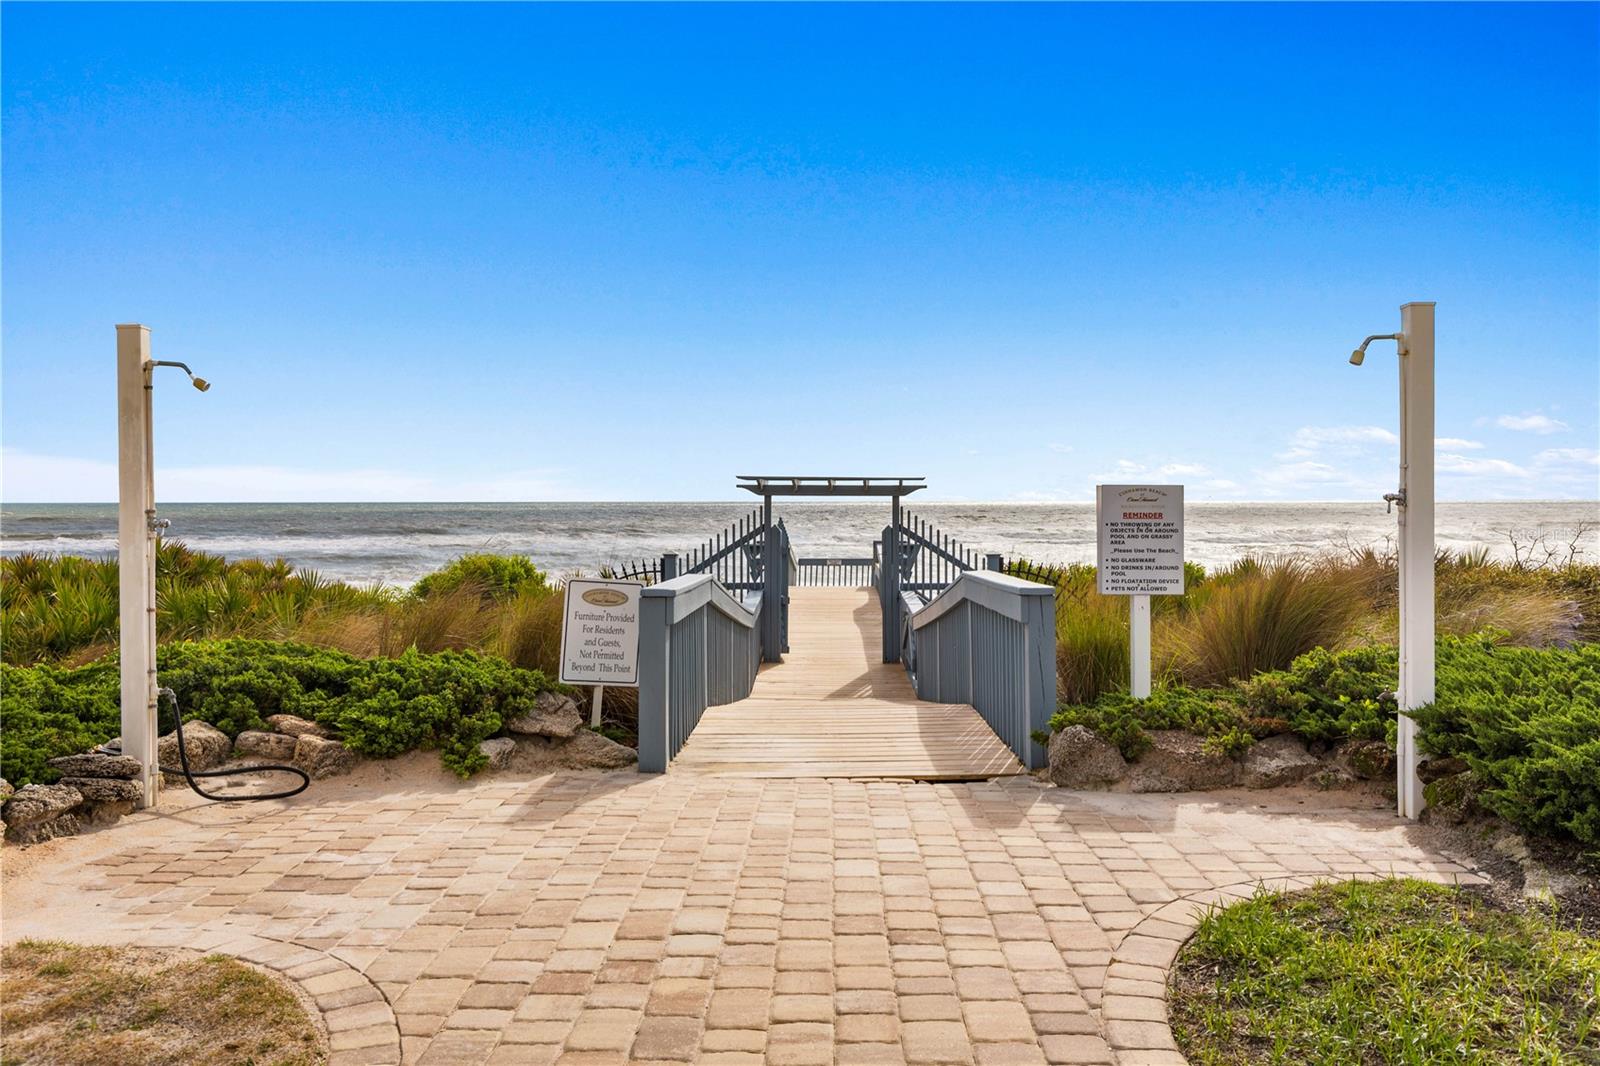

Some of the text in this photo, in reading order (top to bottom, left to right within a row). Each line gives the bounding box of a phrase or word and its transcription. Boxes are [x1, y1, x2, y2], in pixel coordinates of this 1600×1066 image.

[574, 611, 635, 622] Furniture Provided
[583, 624, 625, 634] For Residents
[598, 638, 621, 648] Guests,
[580, 650, 624, 660] Not Permitted
[572, 662, 631, 673] Beyond This Point
